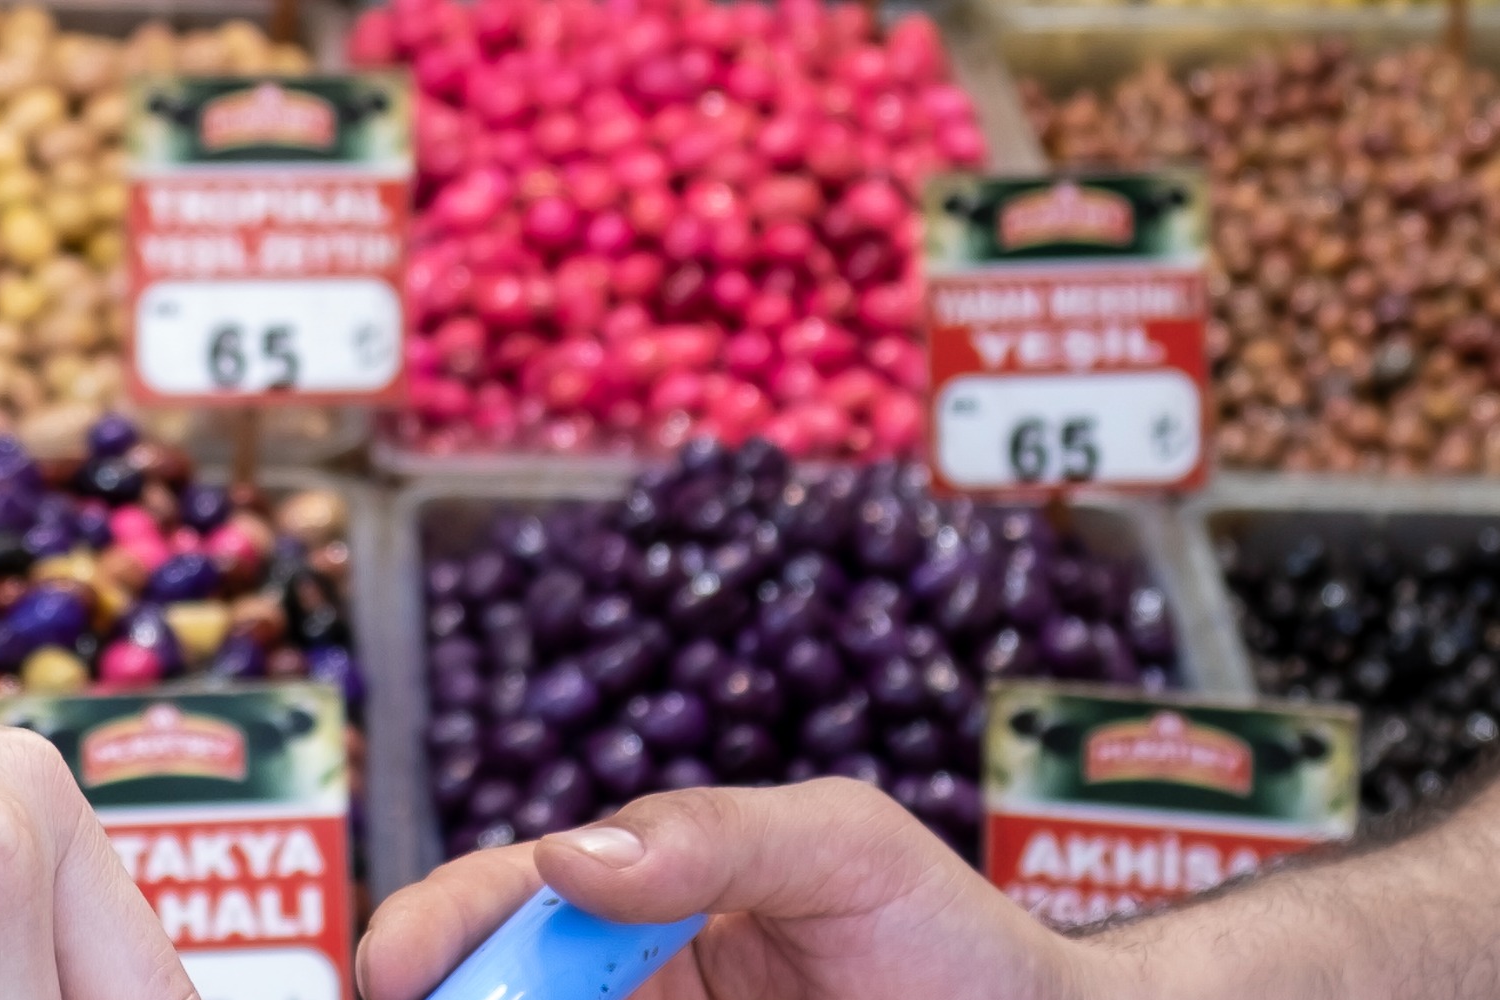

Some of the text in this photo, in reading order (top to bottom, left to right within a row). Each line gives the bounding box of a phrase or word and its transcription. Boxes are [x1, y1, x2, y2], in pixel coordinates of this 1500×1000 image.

[206, 322, 302, 390] 65
[1008, 414, 1102, 484] 65
[108, 826, 326, 885] TAKYA
[1017, 826, 1285, 892] AKHİSA
[156, 884, 325, 944] HALI
